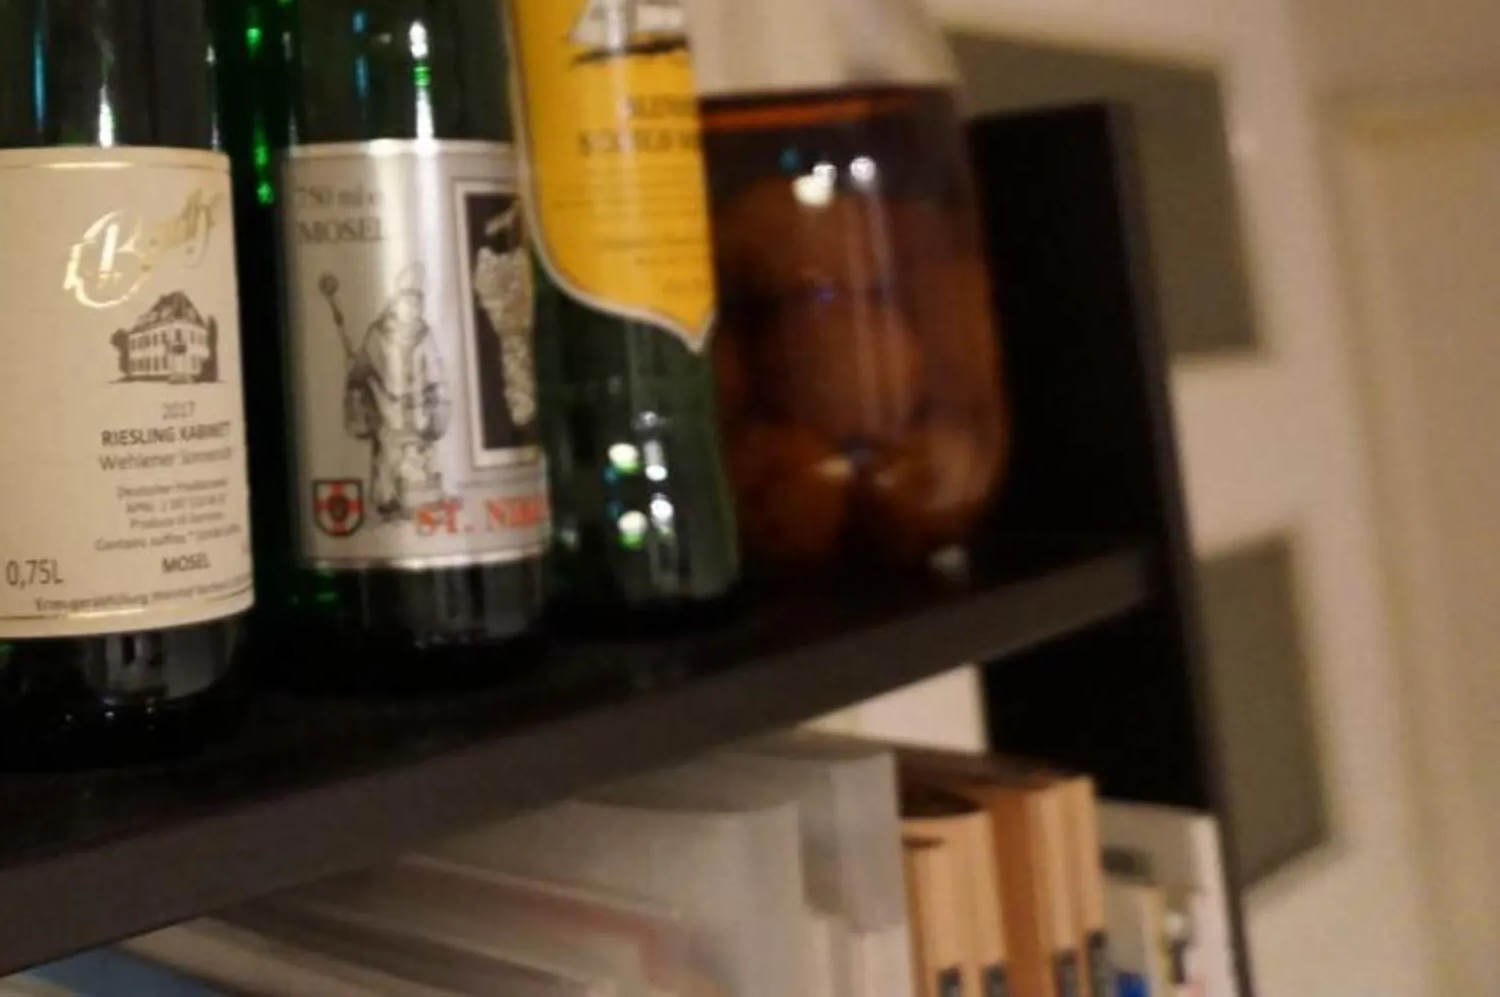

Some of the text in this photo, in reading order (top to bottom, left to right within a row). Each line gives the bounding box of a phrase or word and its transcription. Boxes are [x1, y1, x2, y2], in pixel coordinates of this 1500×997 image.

[100, 426, 176, 446] RIESLING
[162, 553, 211, 573] MOSEL
[5, 559, 64, 588] 0,75L
